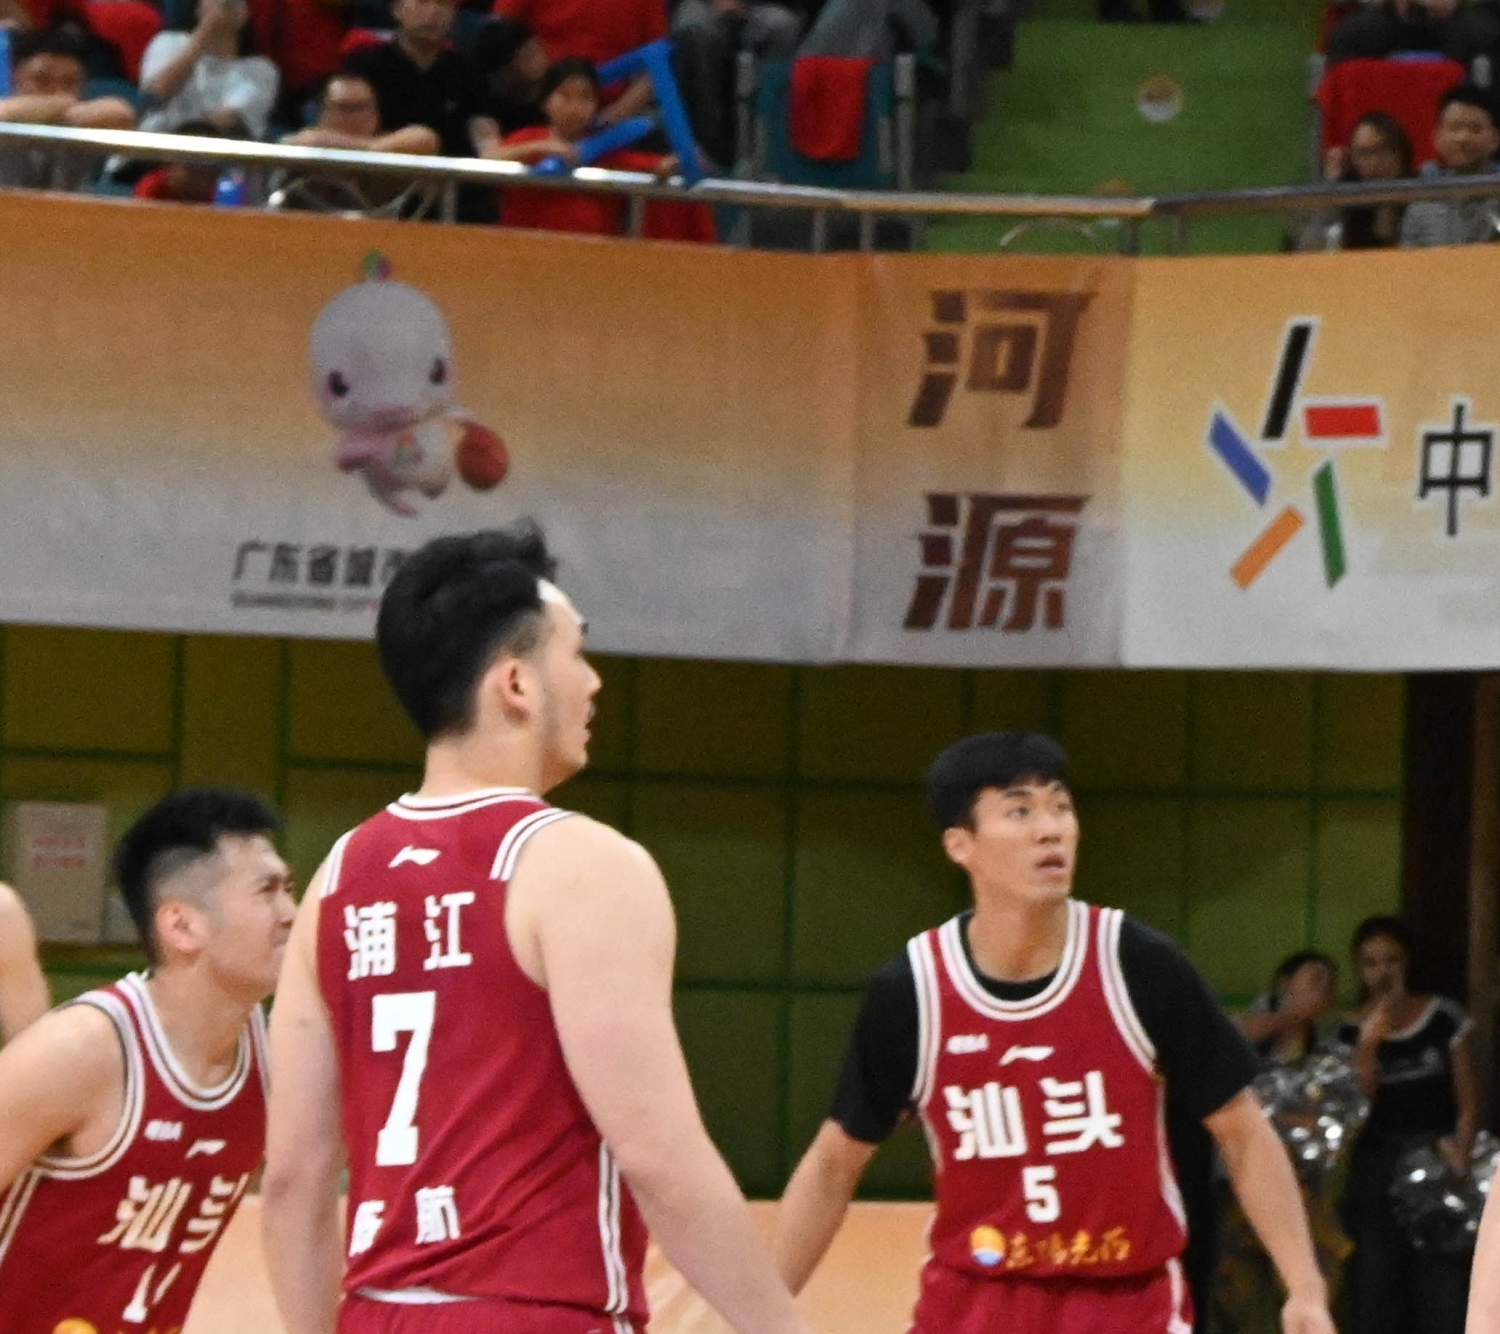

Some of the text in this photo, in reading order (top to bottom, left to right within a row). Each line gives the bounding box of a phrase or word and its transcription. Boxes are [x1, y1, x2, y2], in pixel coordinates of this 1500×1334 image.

[904, 289, 1097, 633] 河源
[343, 890, 476, 981] 浦江
[371, 990, 437, 1167] 7
[944, 1069, 1125, 1161] 汕头
[1022, 1165, 1062, 1223] 5
